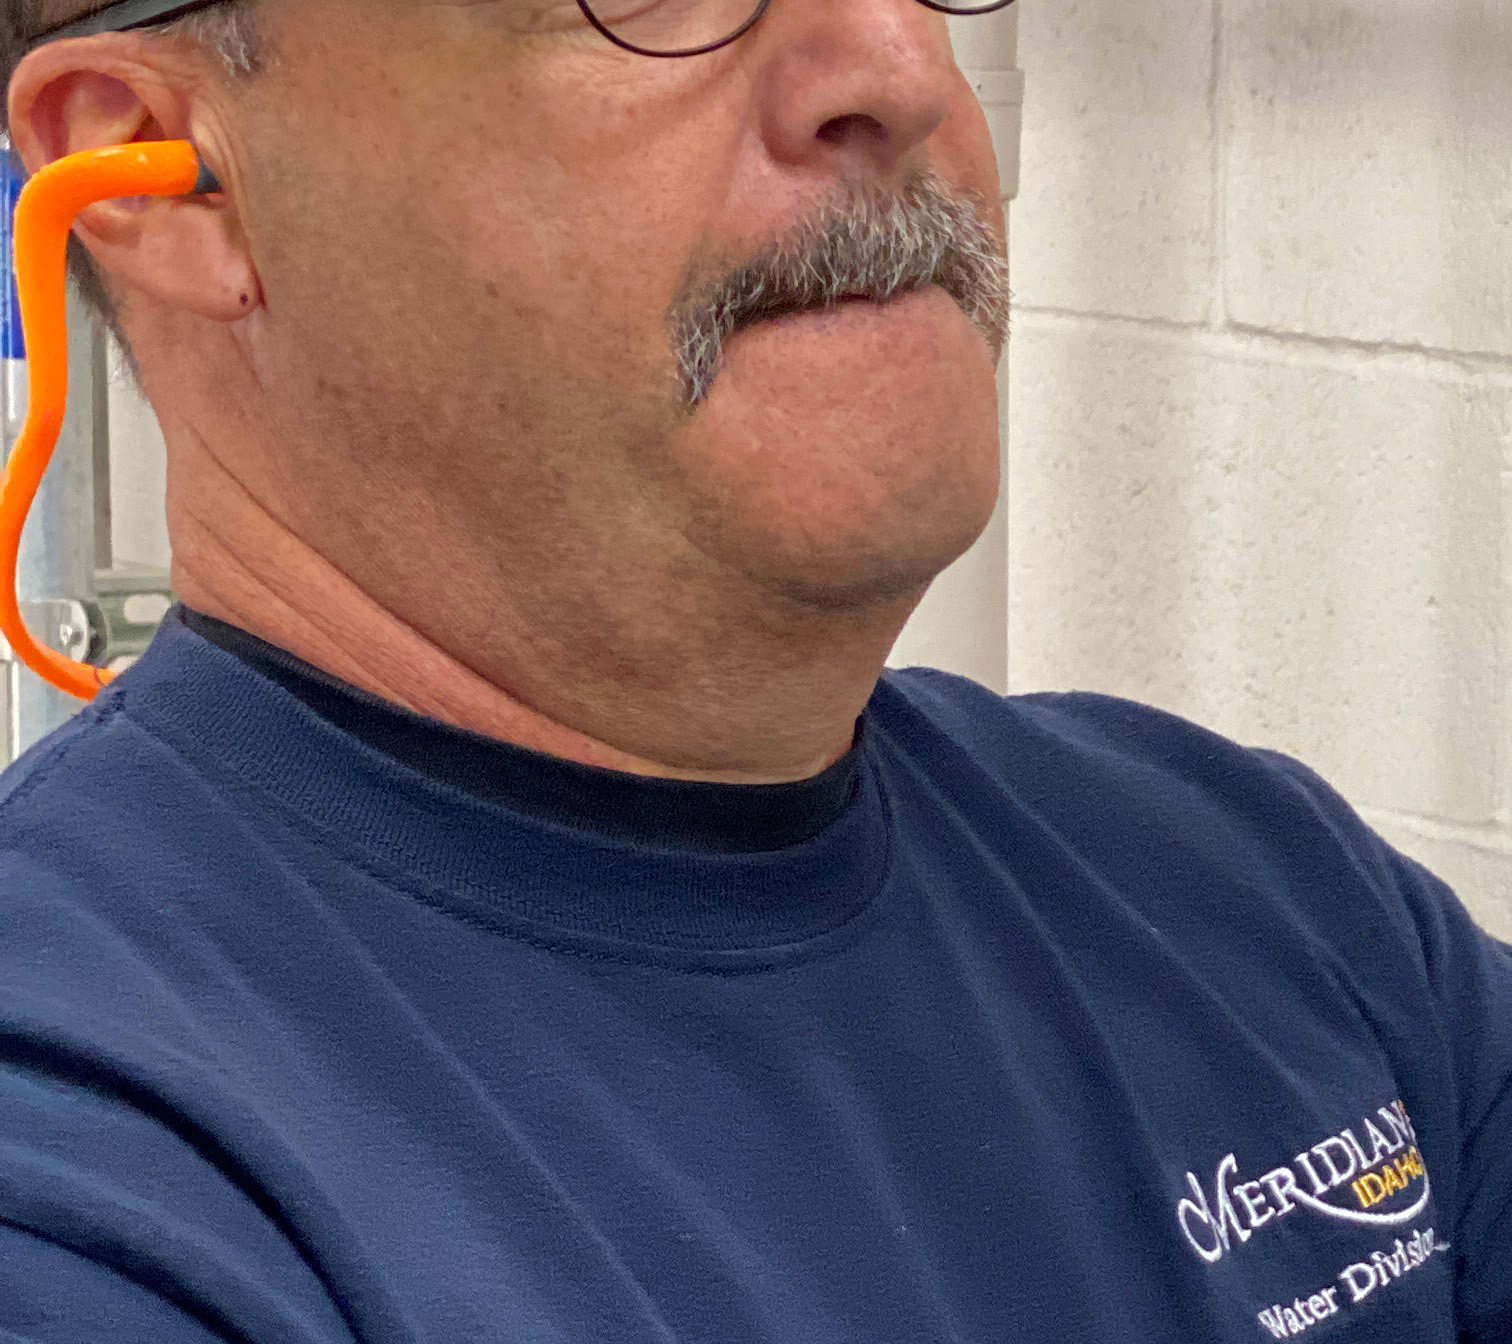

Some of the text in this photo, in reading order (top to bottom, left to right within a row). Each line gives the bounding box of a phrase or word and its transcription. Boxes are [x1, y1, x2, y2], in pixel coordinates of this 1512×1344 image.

[1177, 1100, 1419, 1262] MERIDIAN
[1257, 1227, 1451, 1340] Water Divisio
